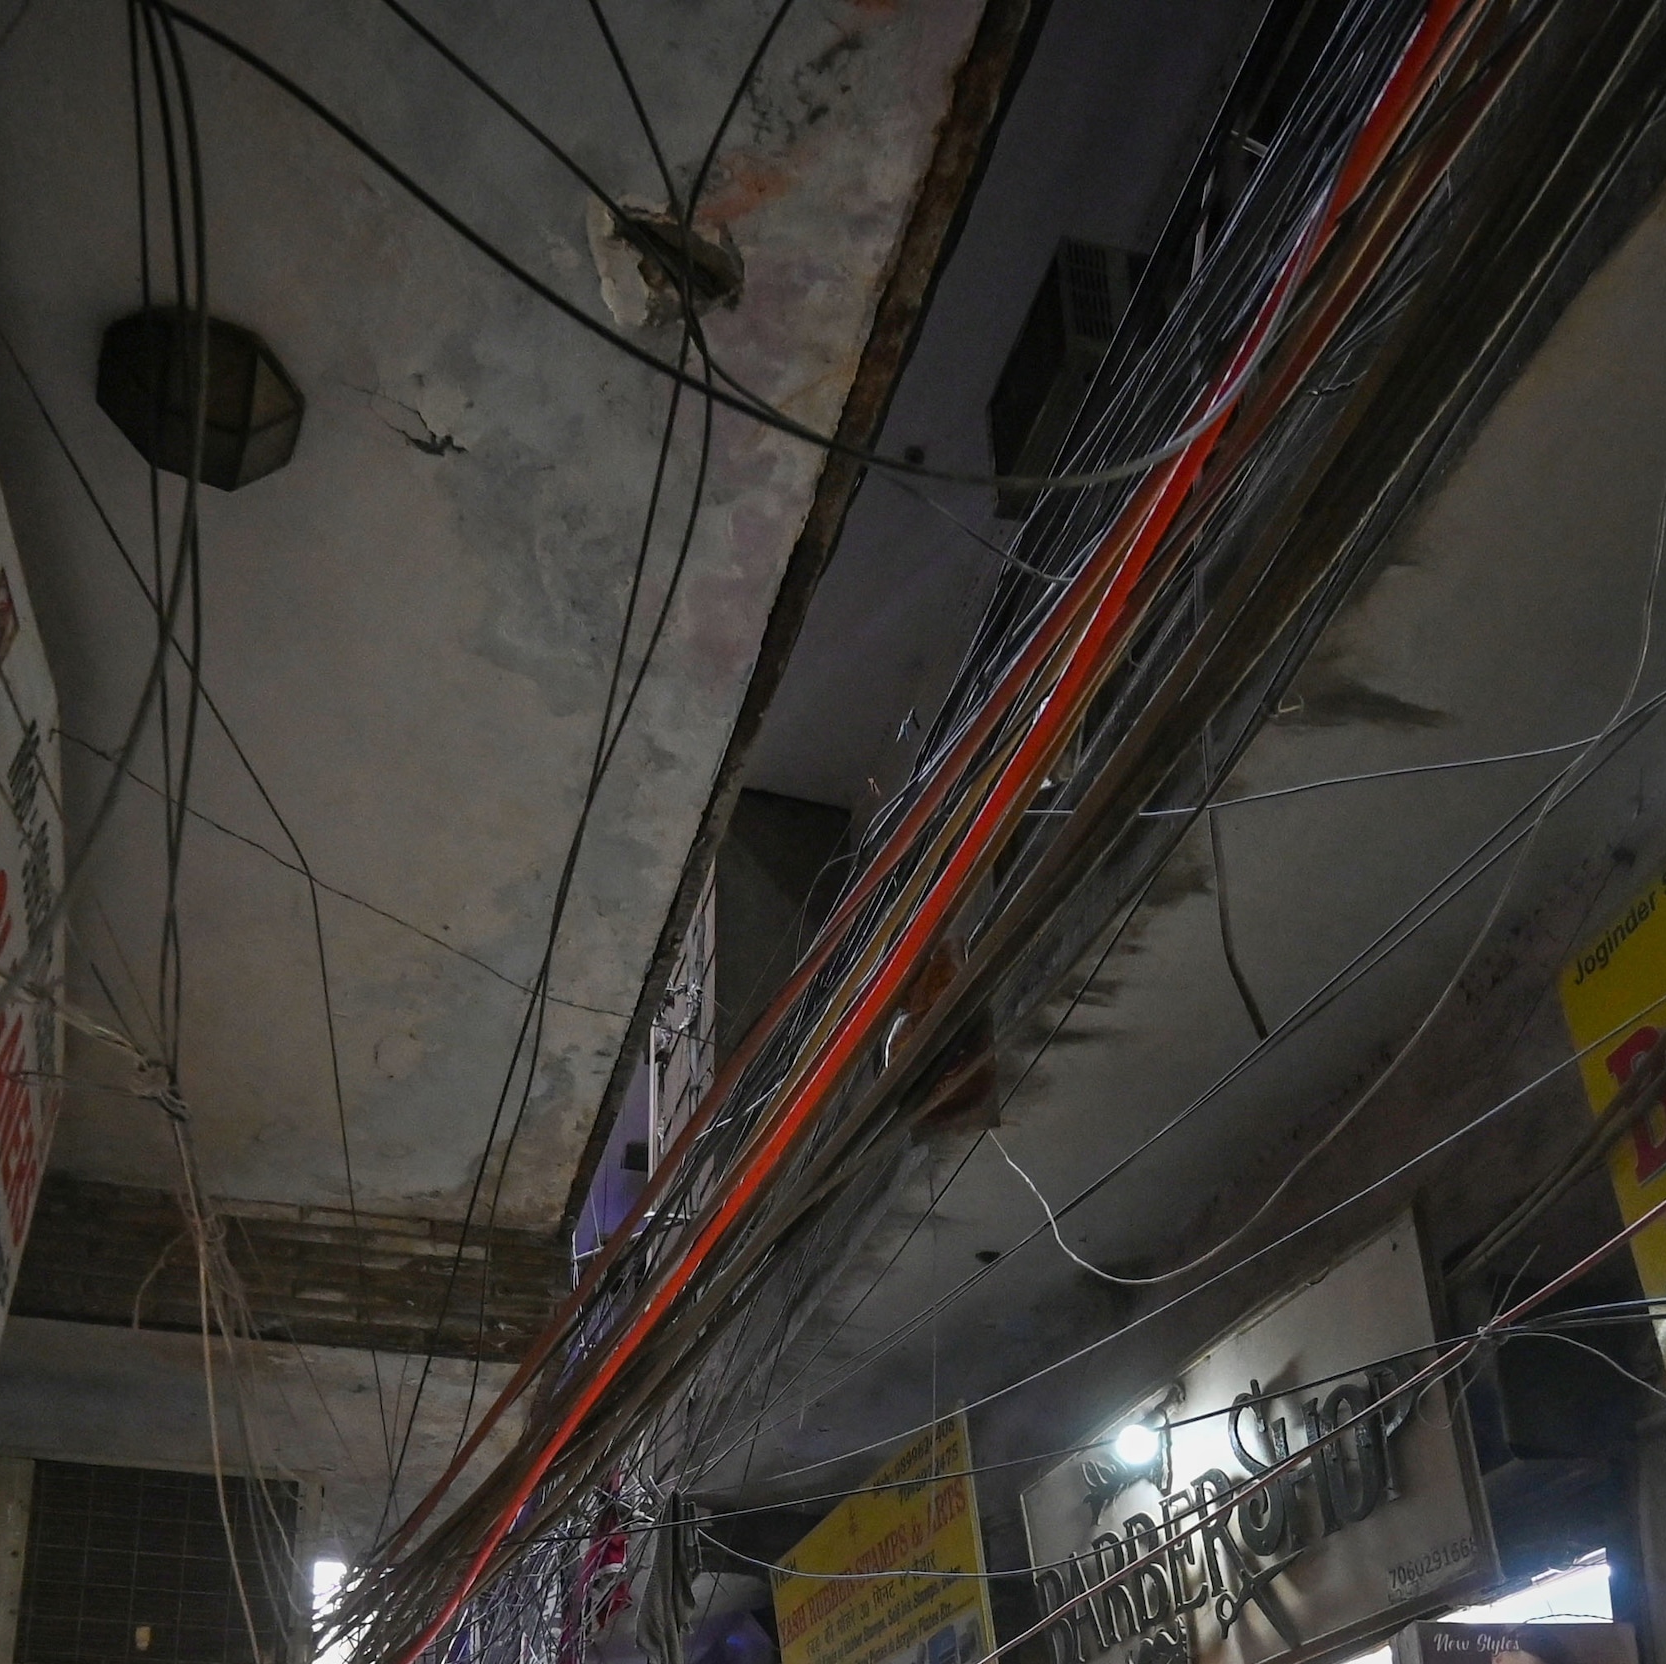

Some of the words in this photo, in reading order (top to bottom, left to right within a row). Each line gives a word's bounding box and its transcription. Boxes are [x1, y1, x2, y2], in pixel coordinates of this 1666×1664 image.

[1573, 895, 1660, 989] Joginder
[1230, 1379, 1413, 1556] SHOP
[1434, 1634, 1471, 1652] New
[1477, 1634, 1520, 1657] Styles
